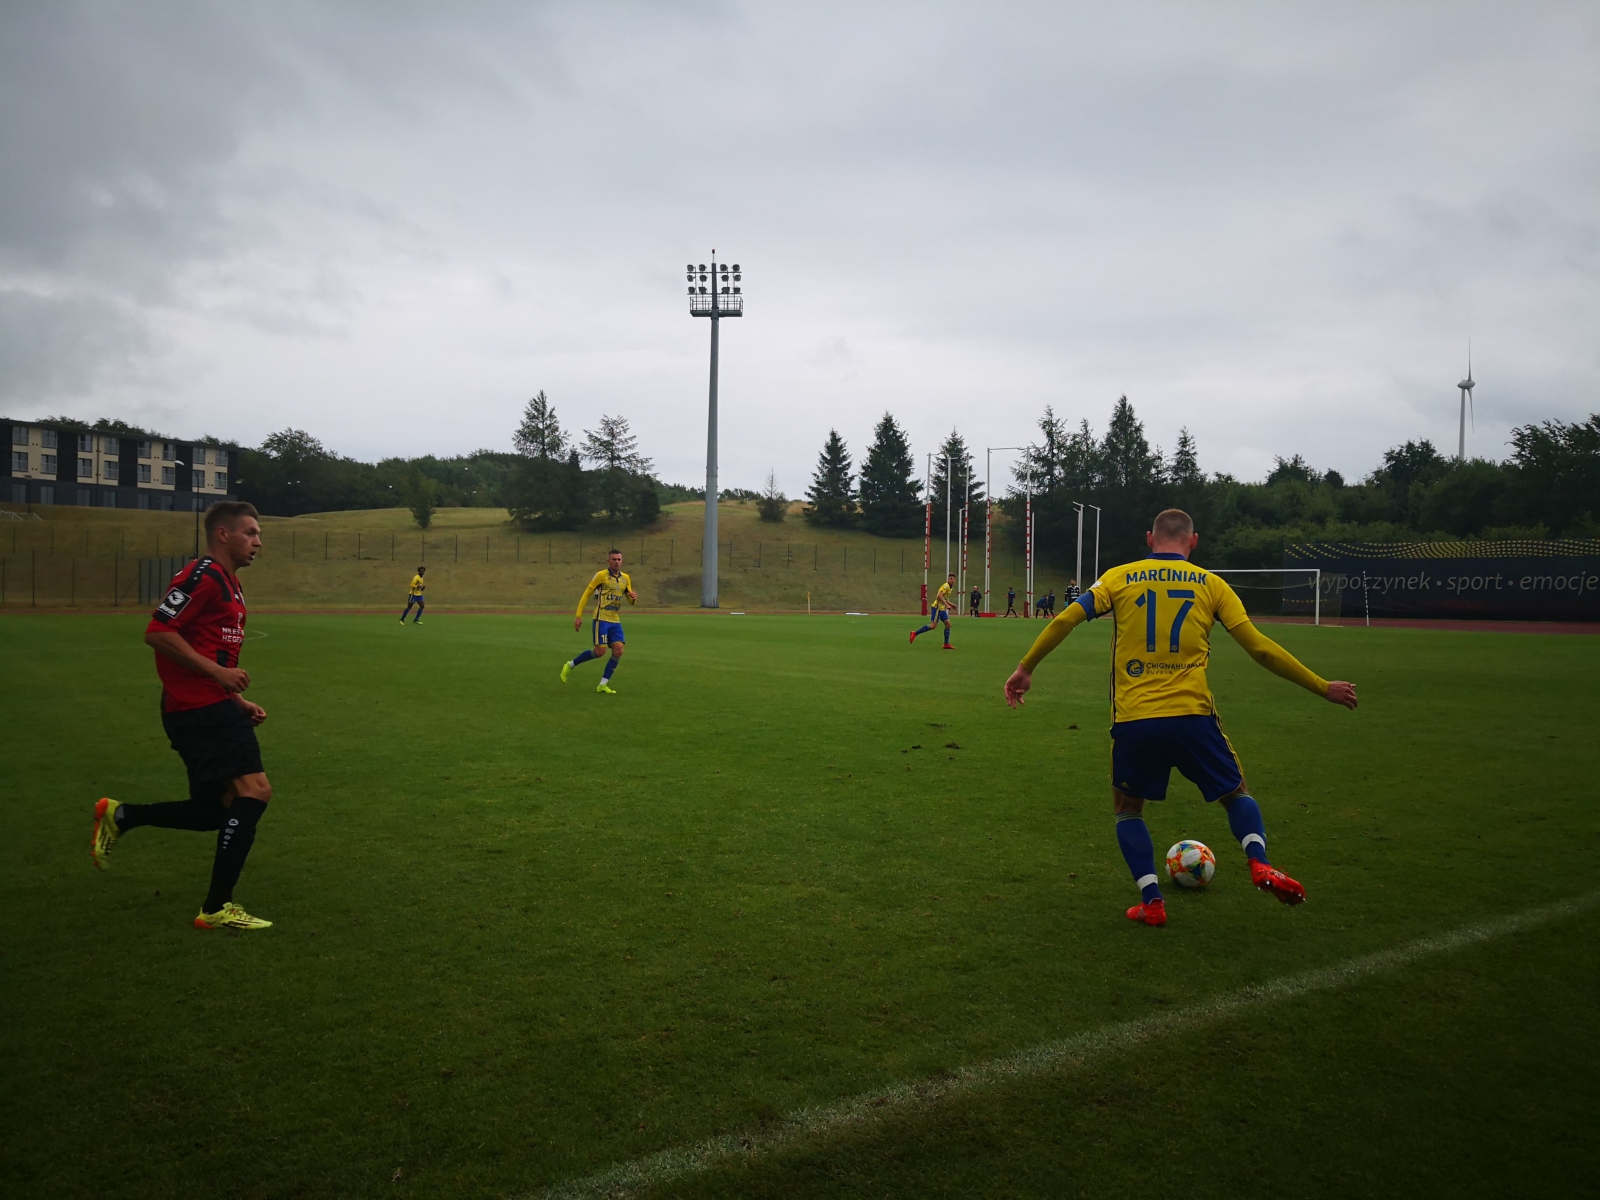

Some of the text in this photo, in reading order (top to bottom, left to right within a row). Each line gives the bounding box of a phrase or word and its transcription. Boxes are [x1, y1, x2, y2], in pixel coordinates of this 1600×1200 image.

[1126, 568, 1207, 585] MARCINIAK
[1308, 571, 1599, 595] wypoczynek sport emocje
[1135, 588, 1195, 653] 17
